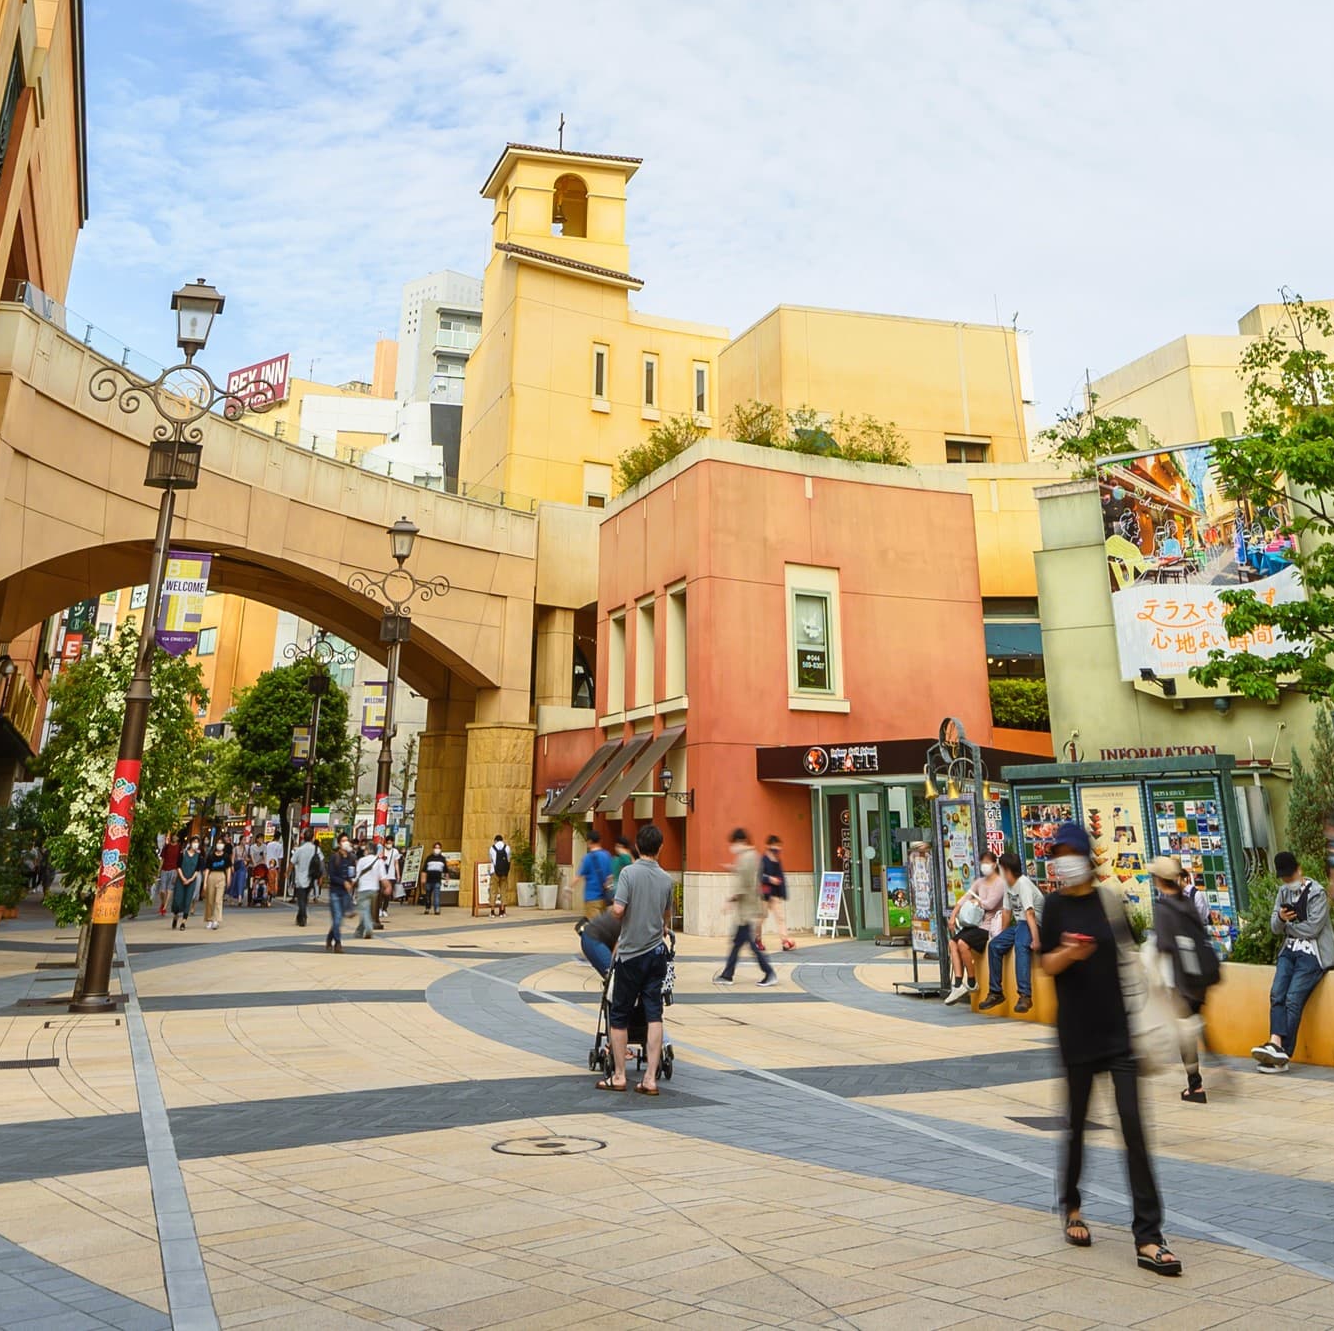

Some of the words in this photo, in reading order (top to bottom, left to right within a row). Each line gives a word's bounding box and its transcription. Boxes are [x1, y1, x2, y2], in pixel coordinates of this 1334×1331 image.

[260, 359, 286, 390] INN
[166, 580, 205, 593] WELCOME
[1137, 587, 1276, 621] テラスです
[1100, 745, 1217, 761] INFORMATION
[831, 754, 878, 772] BEAGLE
